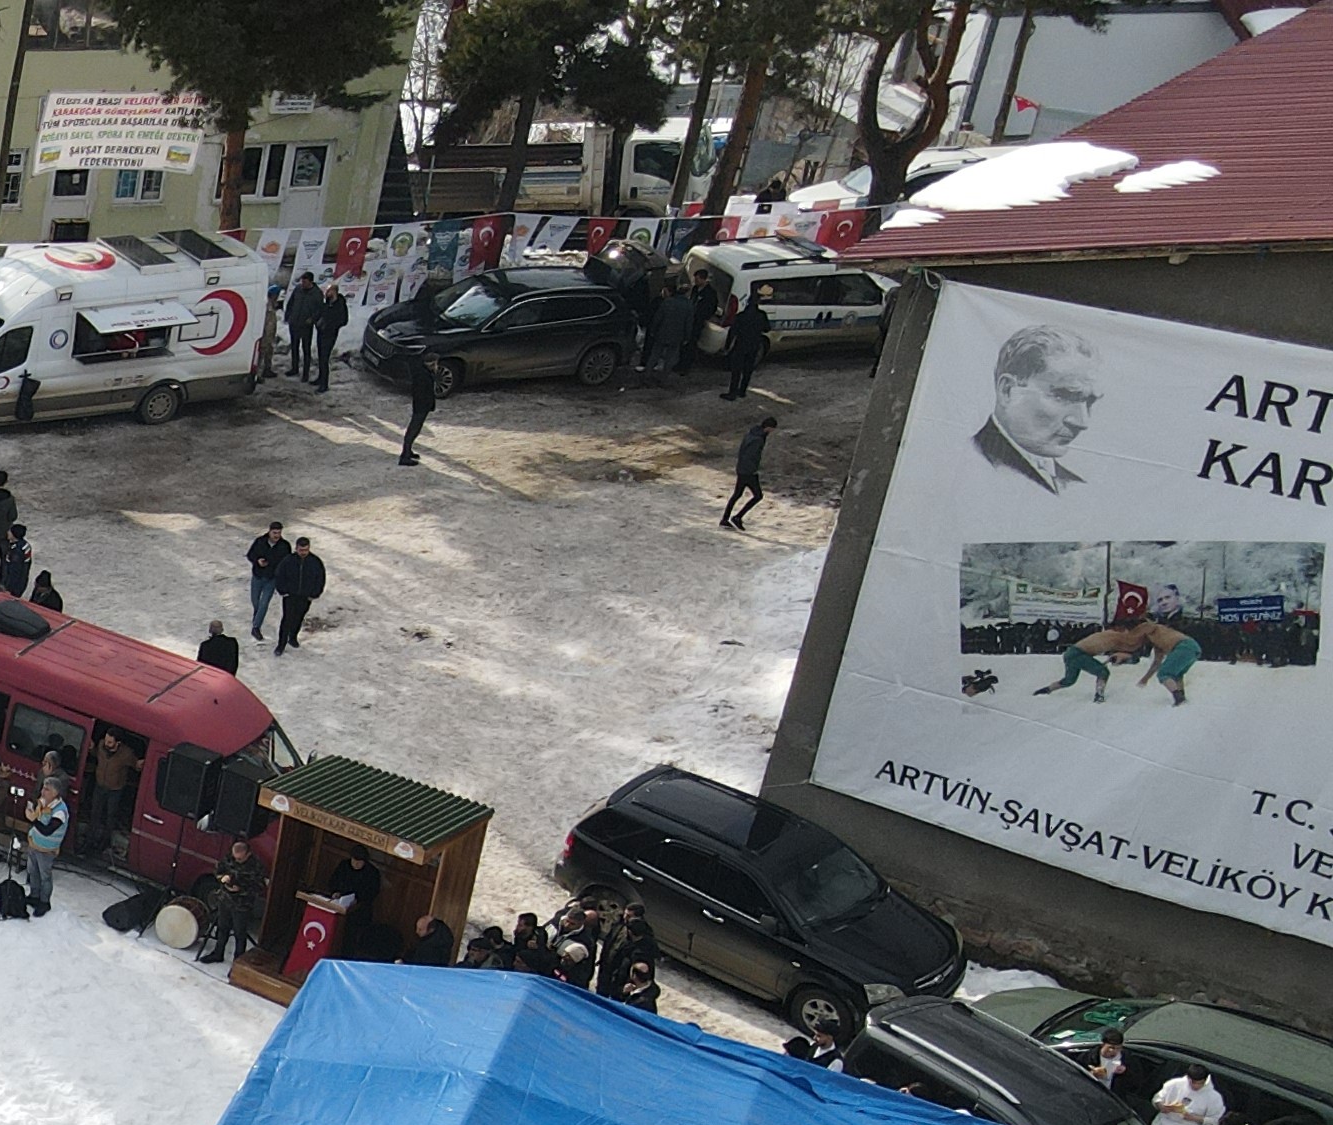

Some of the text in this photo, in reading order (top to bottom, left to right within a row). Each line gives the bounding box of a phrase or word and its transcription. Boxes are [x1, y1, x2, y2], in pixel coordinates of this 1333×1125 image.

[1205, 374, 1333, 434] ART
[1197, 438, 1333, 507] KAR
[1251, 790, 1316, 831] T.C.
[1291, 842, 1333, 879] VE
